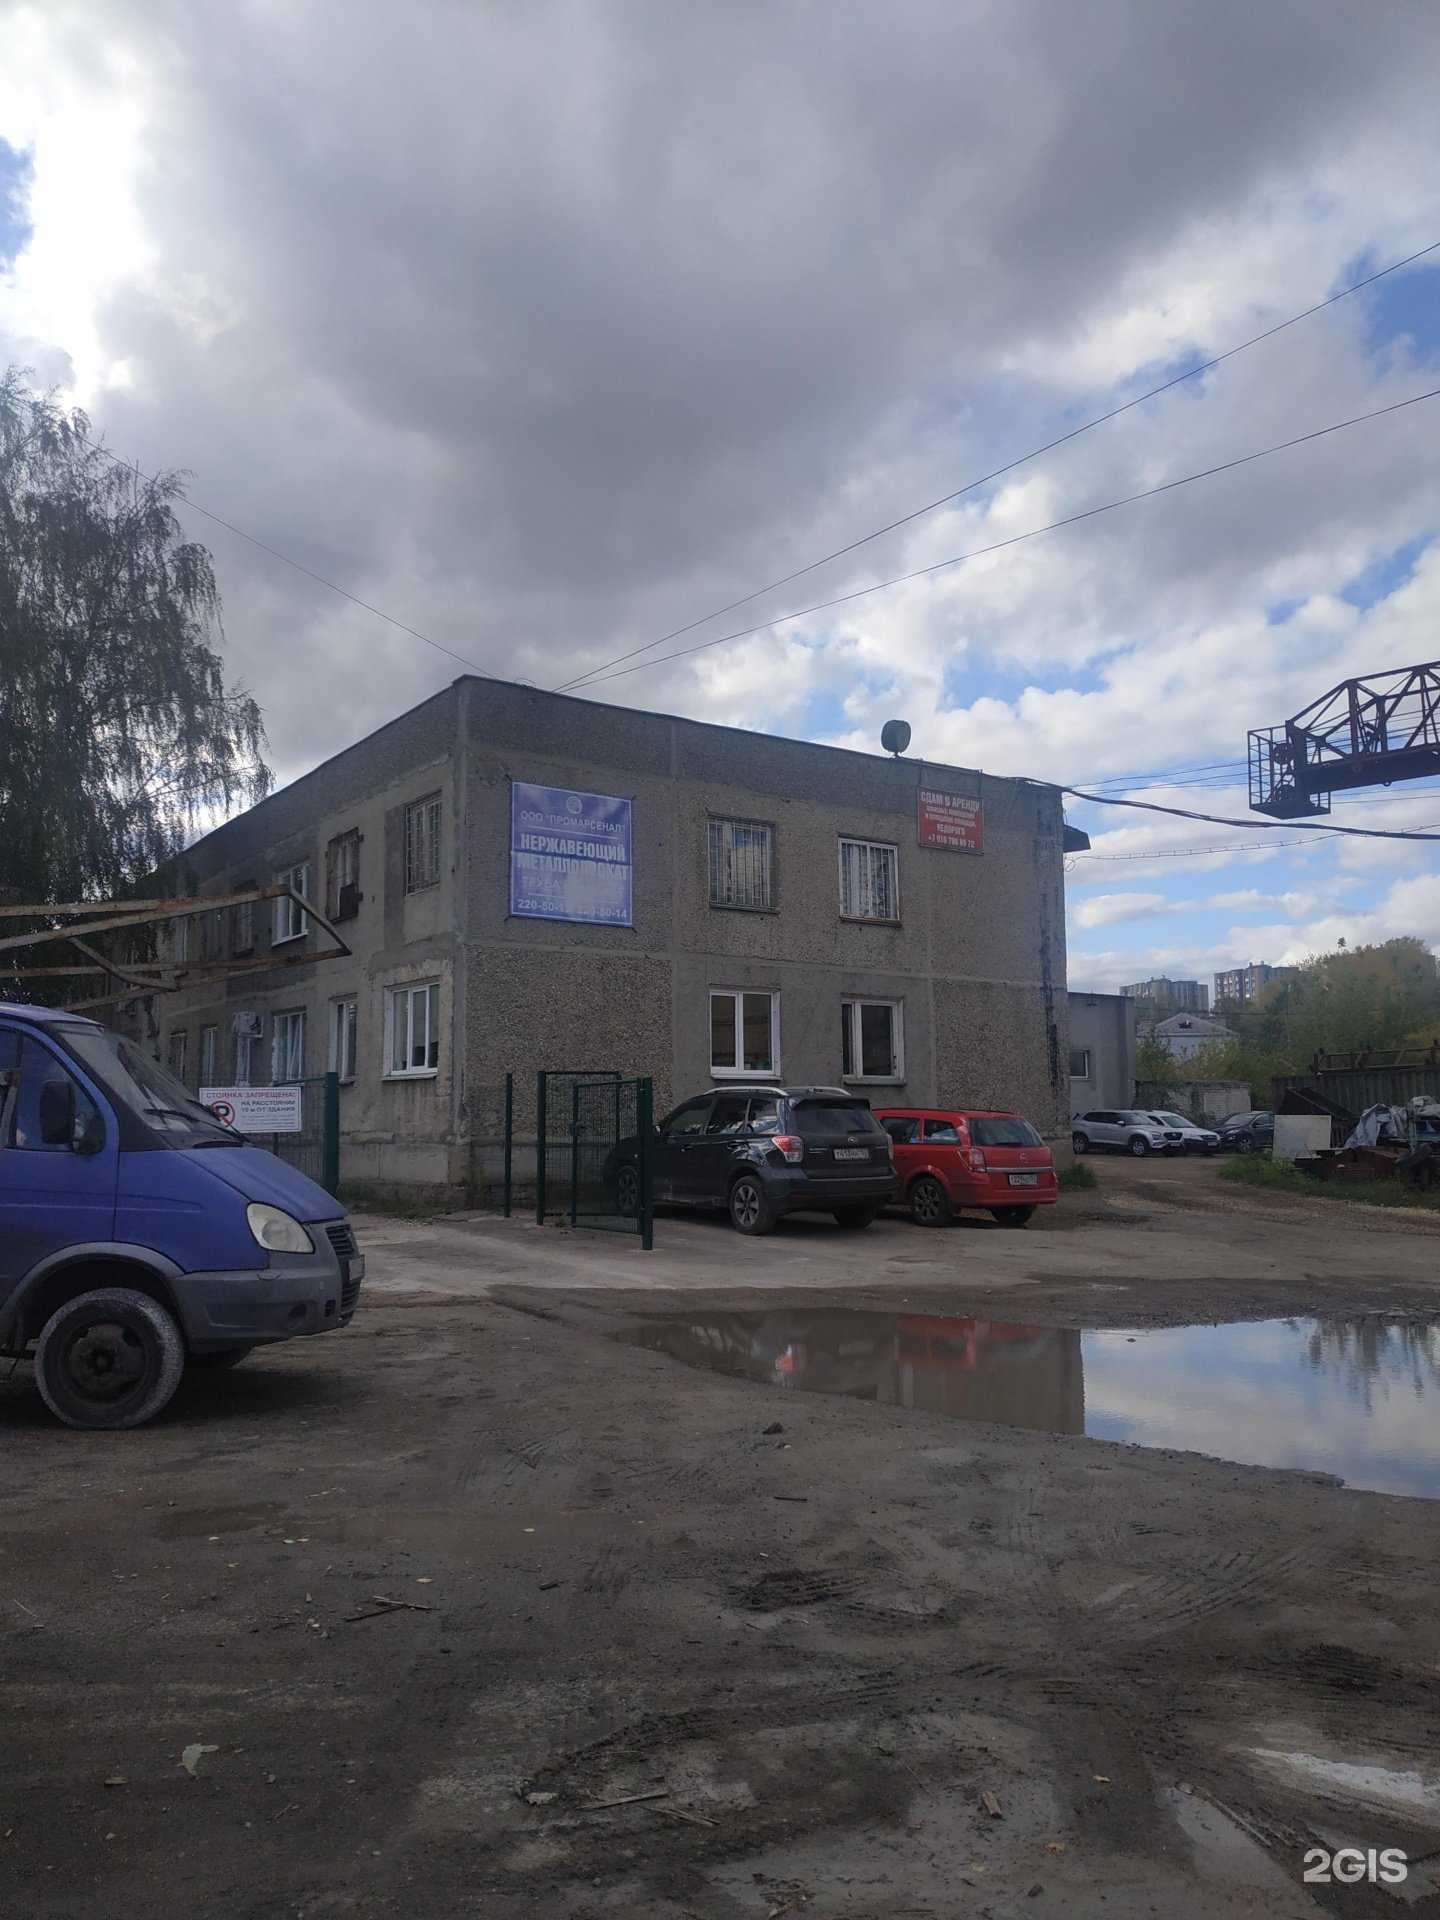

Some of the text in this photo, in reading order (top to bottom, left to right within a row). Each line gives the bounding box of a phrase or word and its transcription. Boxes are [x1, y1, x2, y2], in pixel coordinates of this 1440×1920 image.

[520, 810, 543, 822] ООО
[520, 833, 626, 862] НЕРЖАВЕЮЩИЙ
[206, 1091, 243, 1099] СТОЯНКА
